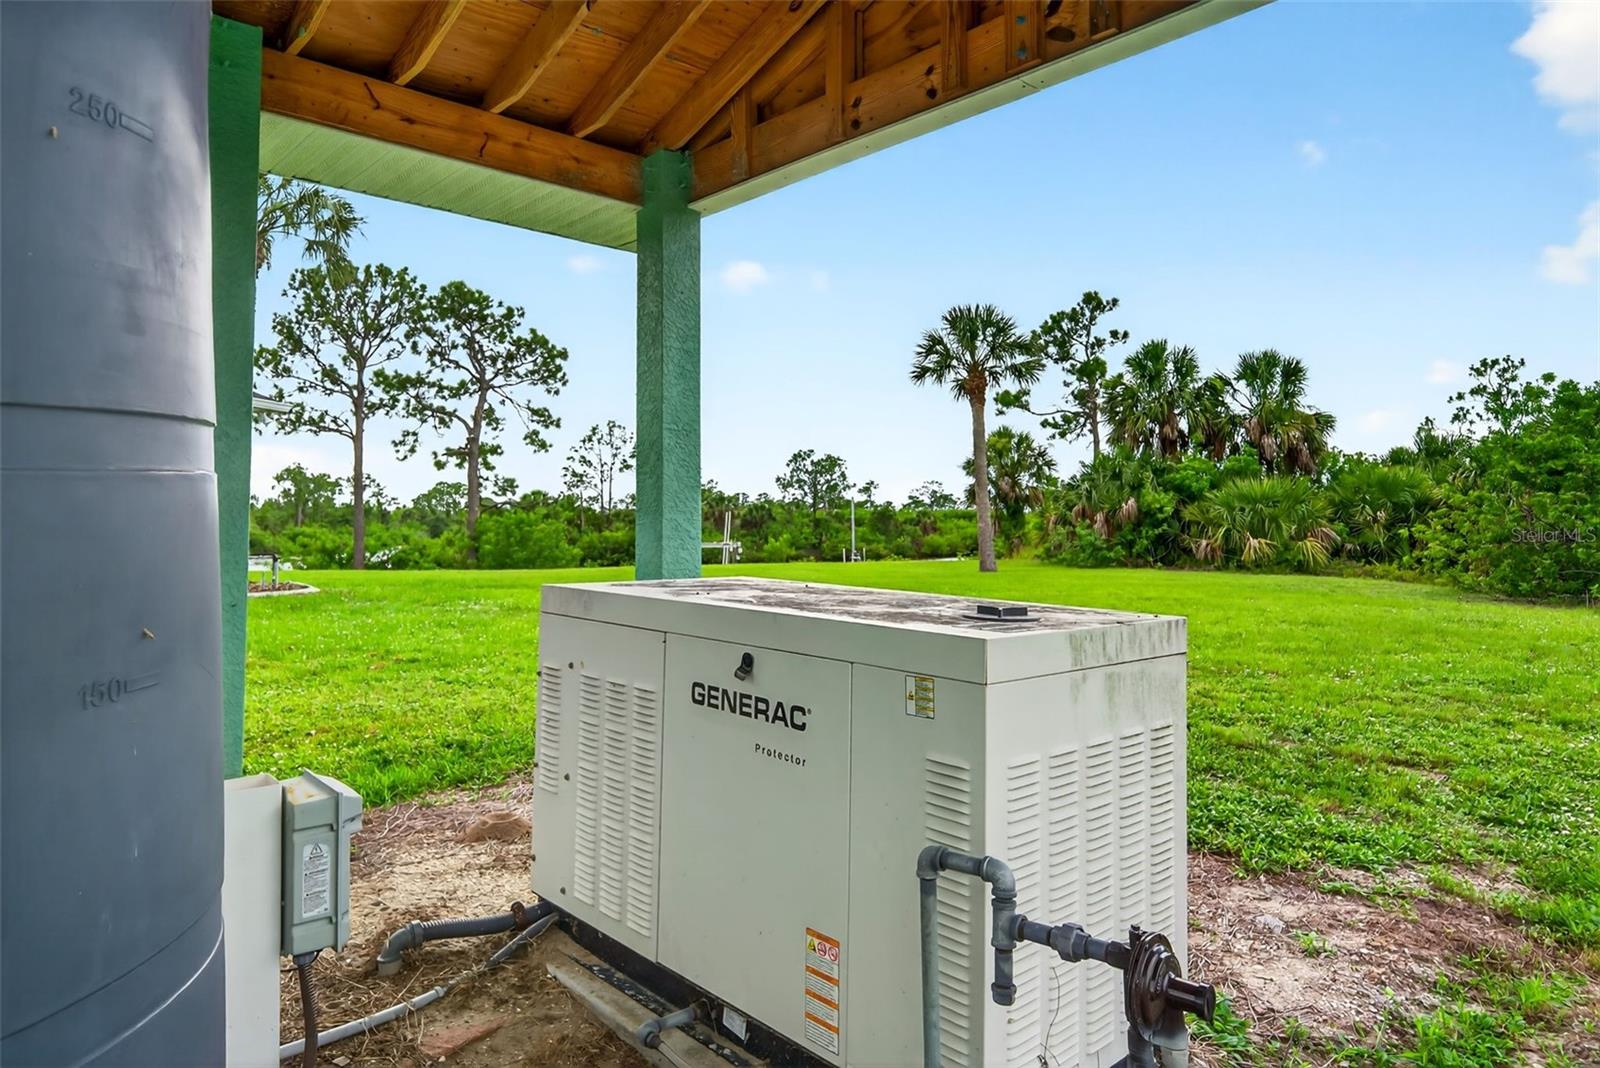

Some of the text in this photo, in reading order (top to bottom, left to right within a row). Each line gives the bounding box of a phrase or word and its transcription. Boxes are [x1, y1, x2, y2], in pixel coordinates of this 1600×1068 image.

[68, 86, 118, 129] 250
[78, 674, 121, 710] 150
[691, 681, 808, 732] GENERAC
[754, 743, 807, 767] Protector
